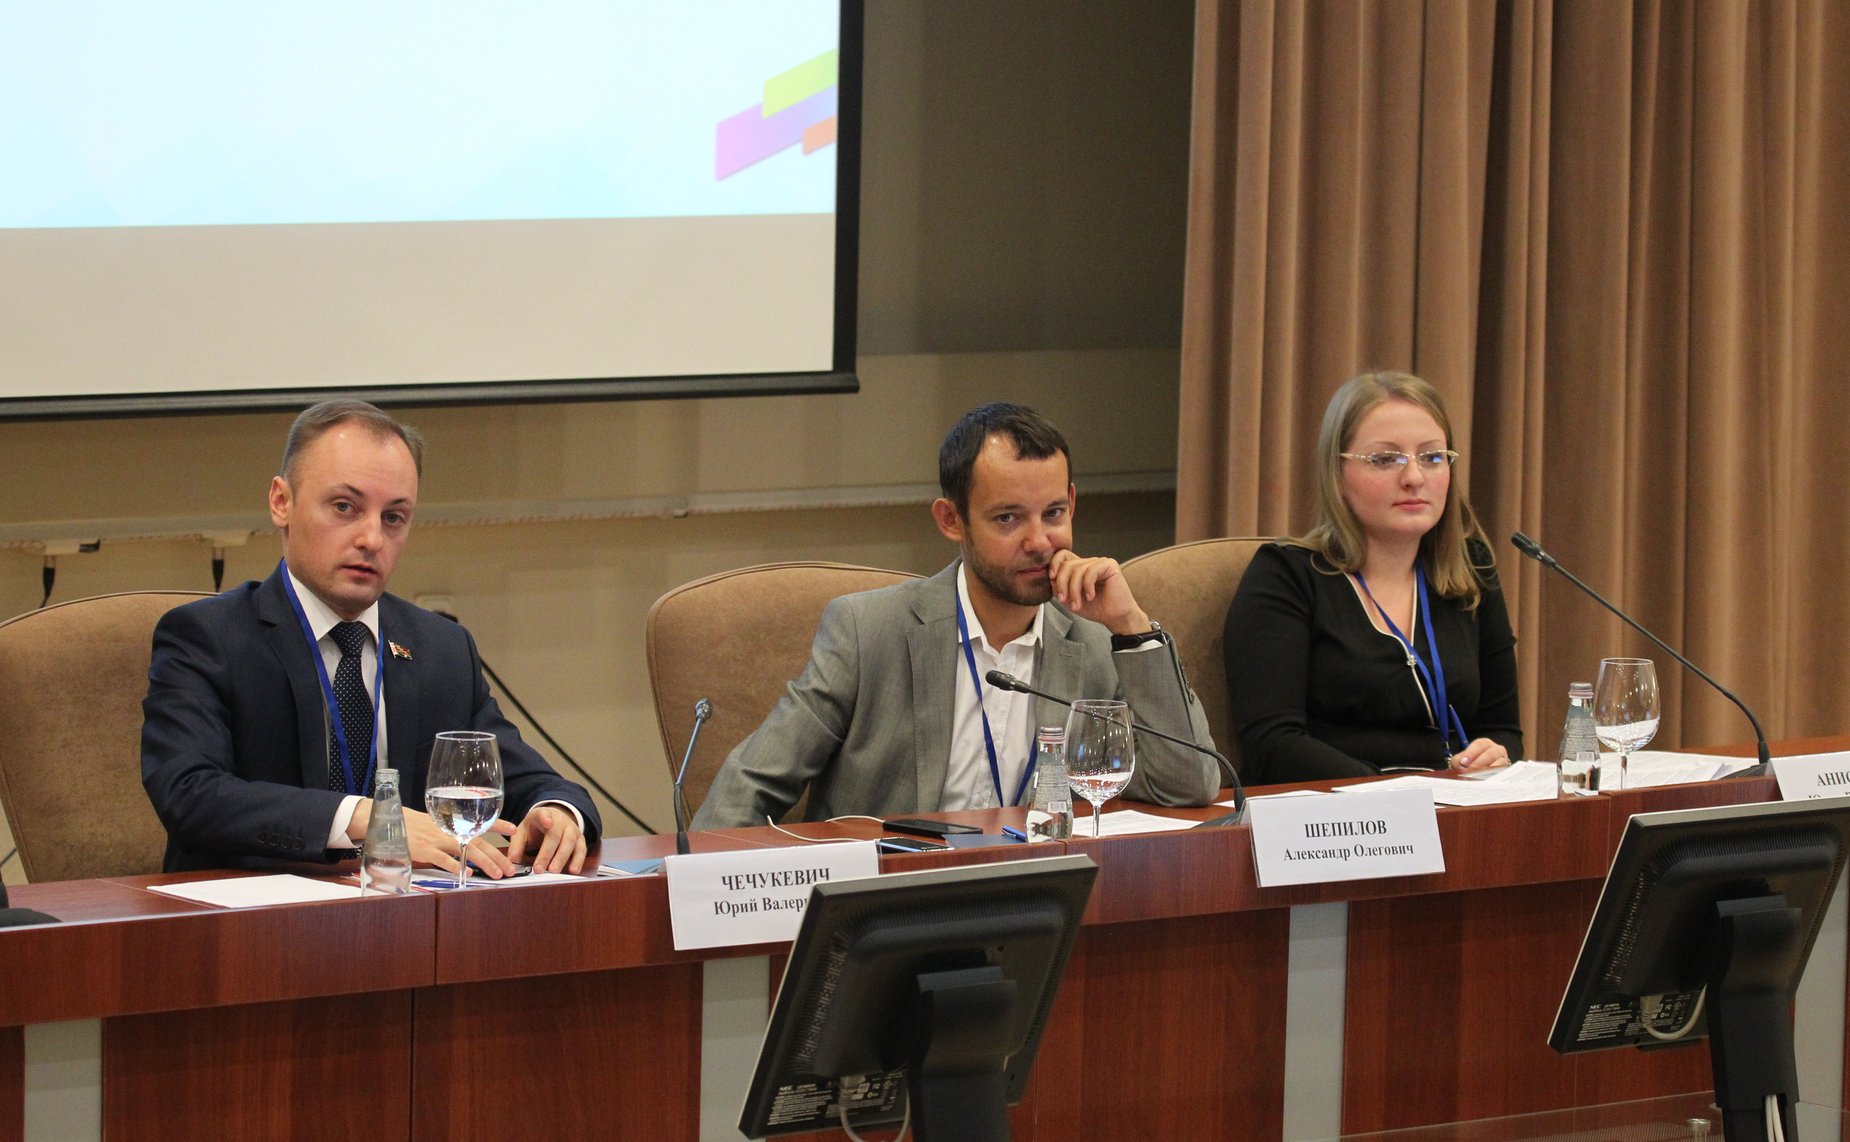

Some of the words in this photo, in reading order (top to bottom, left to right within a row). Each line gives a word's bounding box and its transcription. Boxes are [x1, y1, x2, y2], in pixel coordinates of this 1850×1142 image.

[1305, 820, 1387, 838] ШЕПИЛОВ
[1283, 848, 1350, 861] Александр
[1354, 844, 1414, 857] Олегович
[721, 867, 830, 891] ЧЕЧУКЕВИЧ
[714, 900, 758, 917] Юрий
[762, 897, 808, 912] Валер
